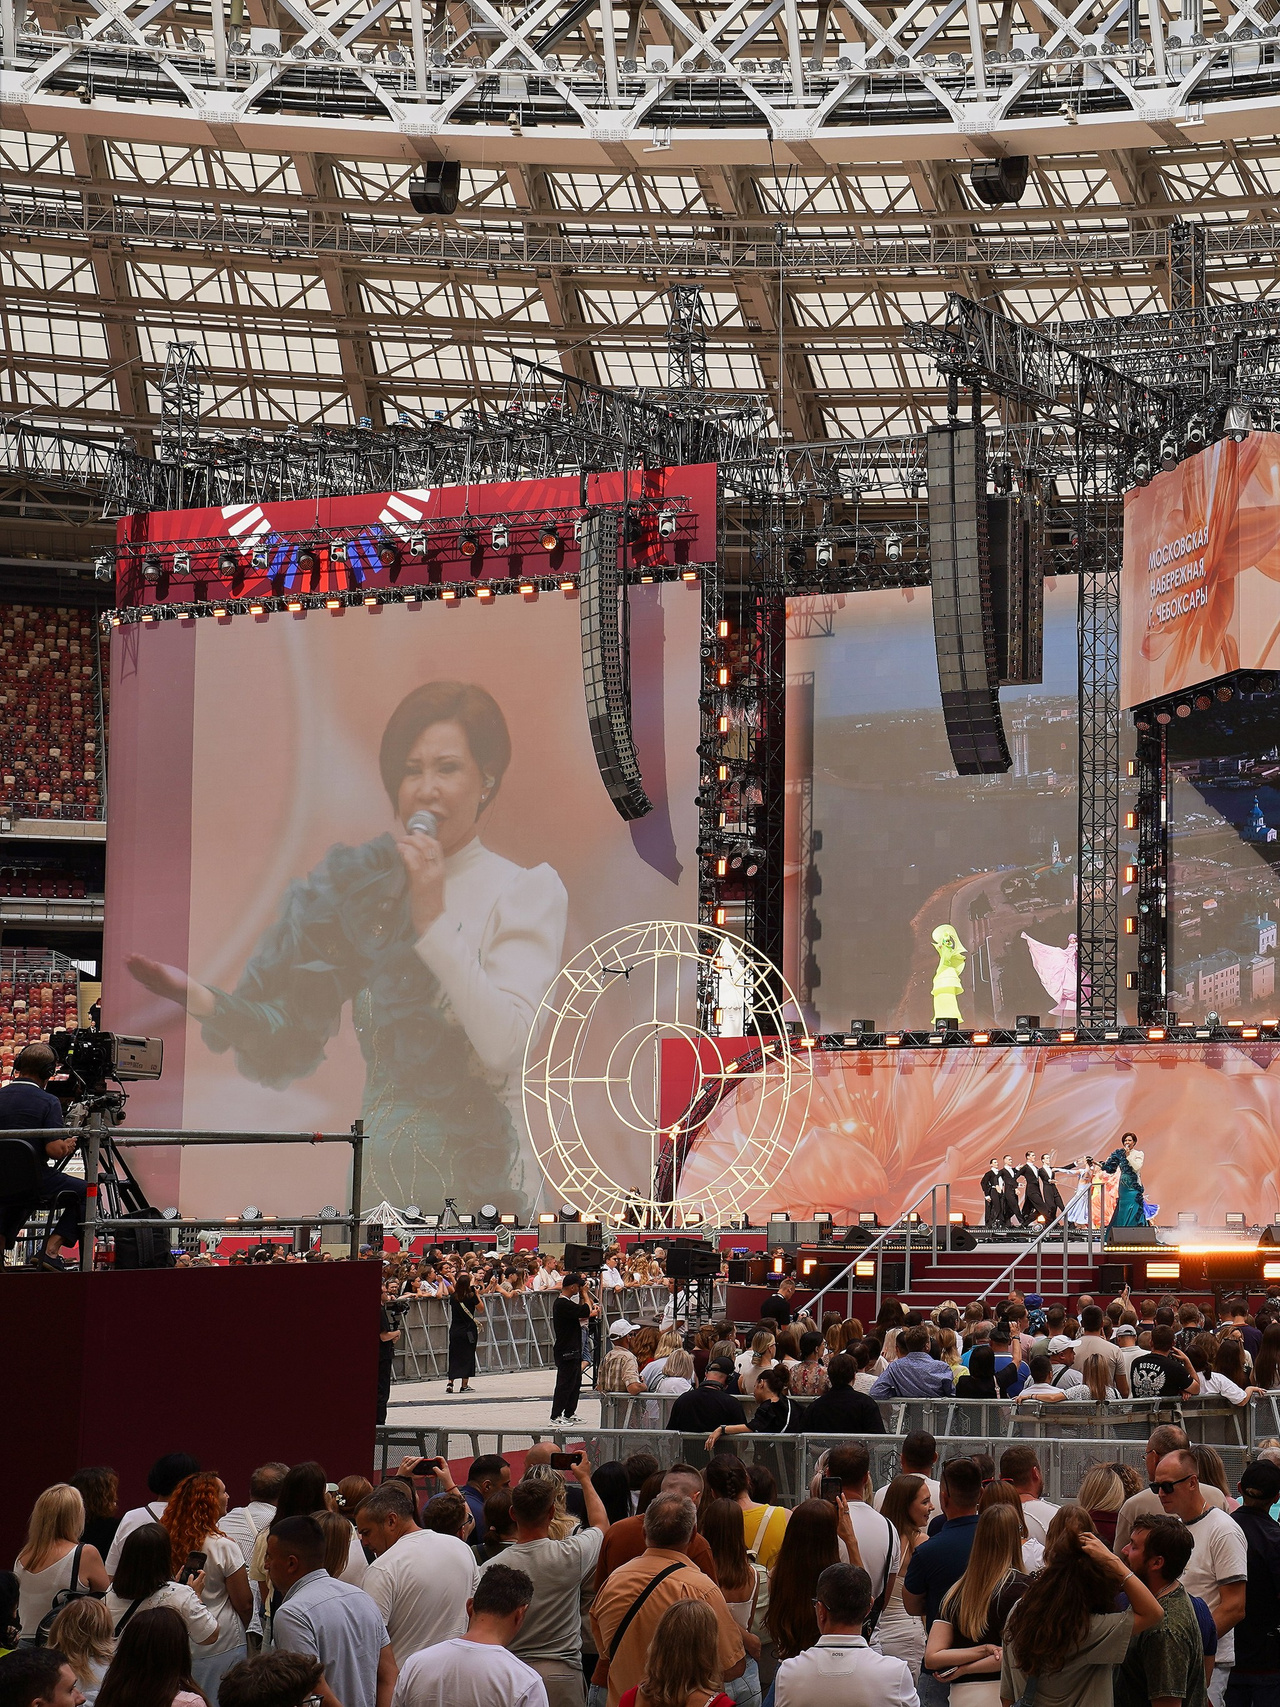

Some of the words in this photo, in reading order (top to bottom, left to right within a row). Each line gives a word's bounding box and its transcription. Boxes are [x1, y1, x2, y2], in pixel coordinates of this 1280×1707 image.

[1149, 525, 1209, 571] МОСКОВСКАЯ
[1150, 557, 1207, 598] НАБЕРЕЖНАЯ,
[1148, 608, 1155, 627] Г.
[1156, 585, 1208, 624] ЧЕБОКСАРЫ
[1139, 1362, 1161, 1372] RUSSIA
